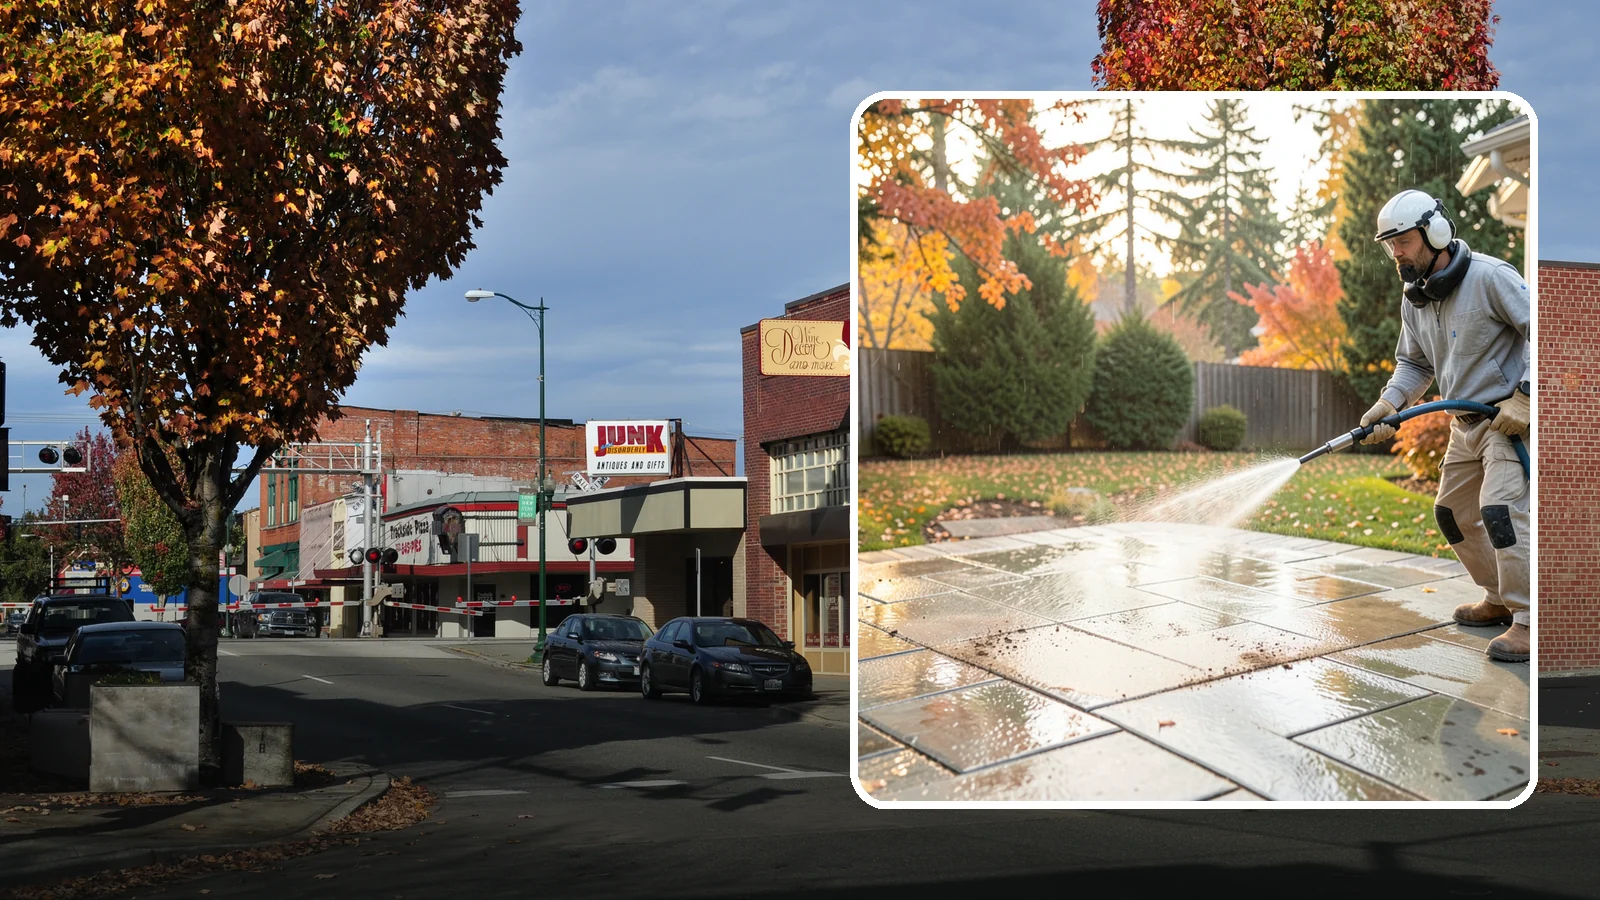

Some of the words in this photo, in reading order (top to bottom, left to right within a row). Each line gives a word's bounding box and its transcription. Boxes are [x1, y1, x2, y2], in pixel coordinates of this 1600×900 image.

[596, 425, 664, 457] JUNK
[607, 446, 645, 454] DISORDERLY
[596, 461, 628, 470] ANTIQUES
[631, 461, 644, 470] AND
[647, 461, 665, 470] GIFTS
[391, 521, 412, 539] Trackside
[414, 519, 429, 535] Pizza
